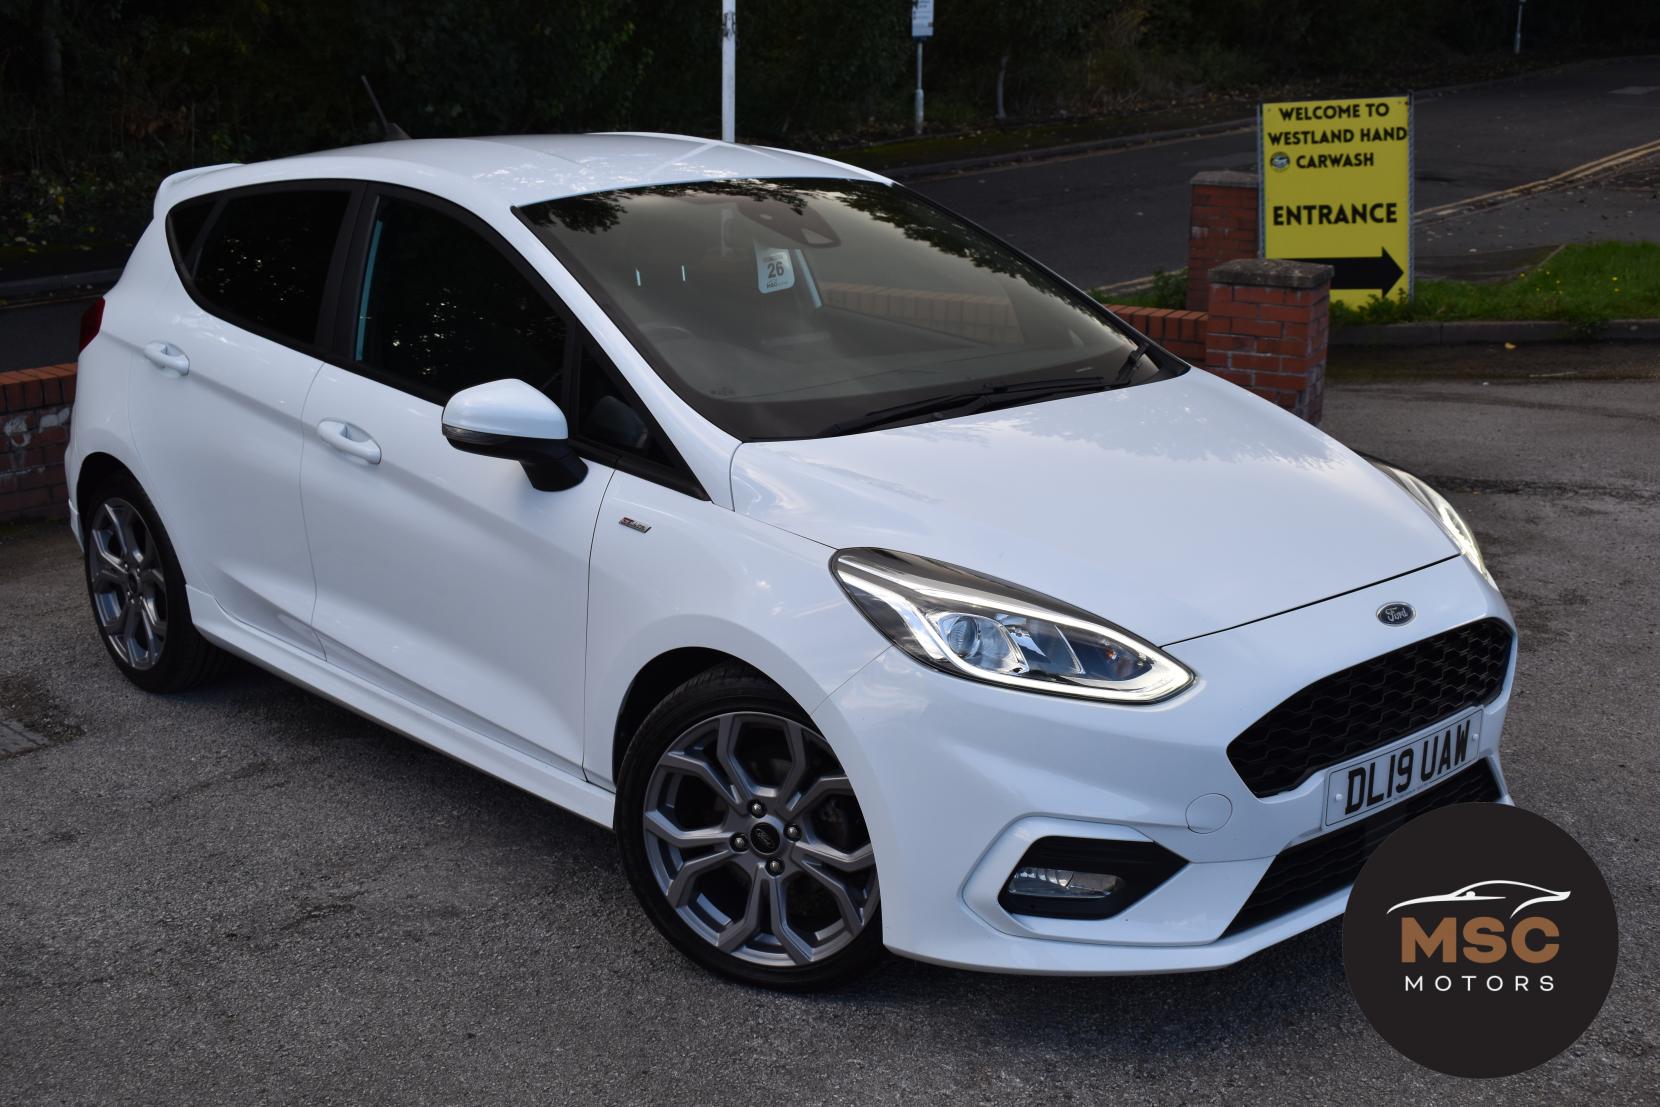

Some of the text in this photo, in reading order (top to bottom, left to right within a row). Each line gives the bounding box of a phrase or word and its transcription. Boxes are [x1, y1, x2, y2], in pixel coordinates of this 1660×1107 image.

[1278, 102, 1390, 121] WELCOME TO
[1267, 127, 1407, 146] WESTLAND HAND
[1296, 152, 1374, 169] CARWASH
[1273, 203, 1397, 226] ENTRANCE
[767, 260, 785, 279] 26
[1385, 606, 1409, 622] Ford
[1344, 719, 1471, 815] DL19 UAW
